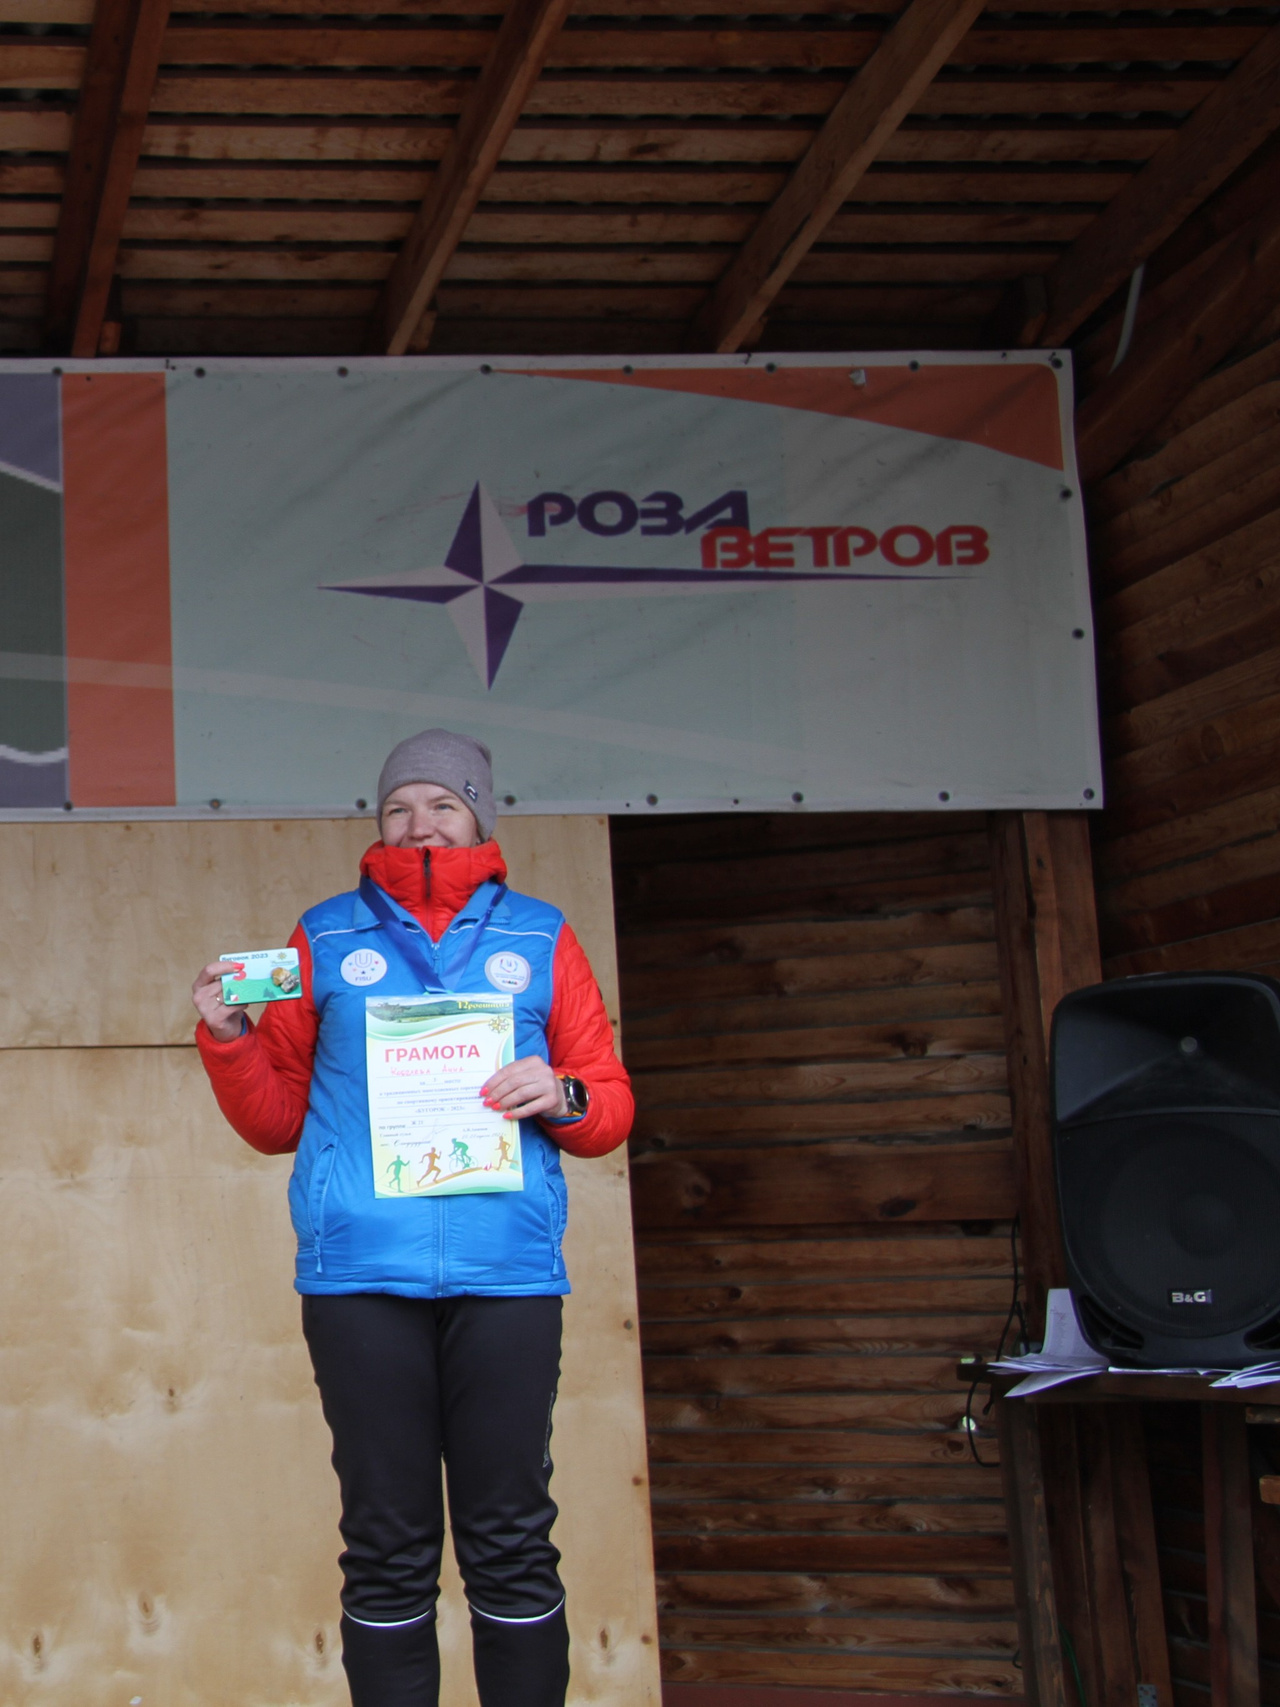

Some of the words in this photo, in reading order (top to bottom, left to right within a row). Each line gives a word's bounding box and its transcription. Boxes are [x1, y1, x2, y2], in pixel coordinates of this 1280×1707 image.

[528, 490, 750, 537] РОЗА
[700, 524, 990, 569] ВЕТРОВ
[384, 1044, 480, 1063] ГРАМОТА
[1172, 1291, 1206, 1303] B&G
